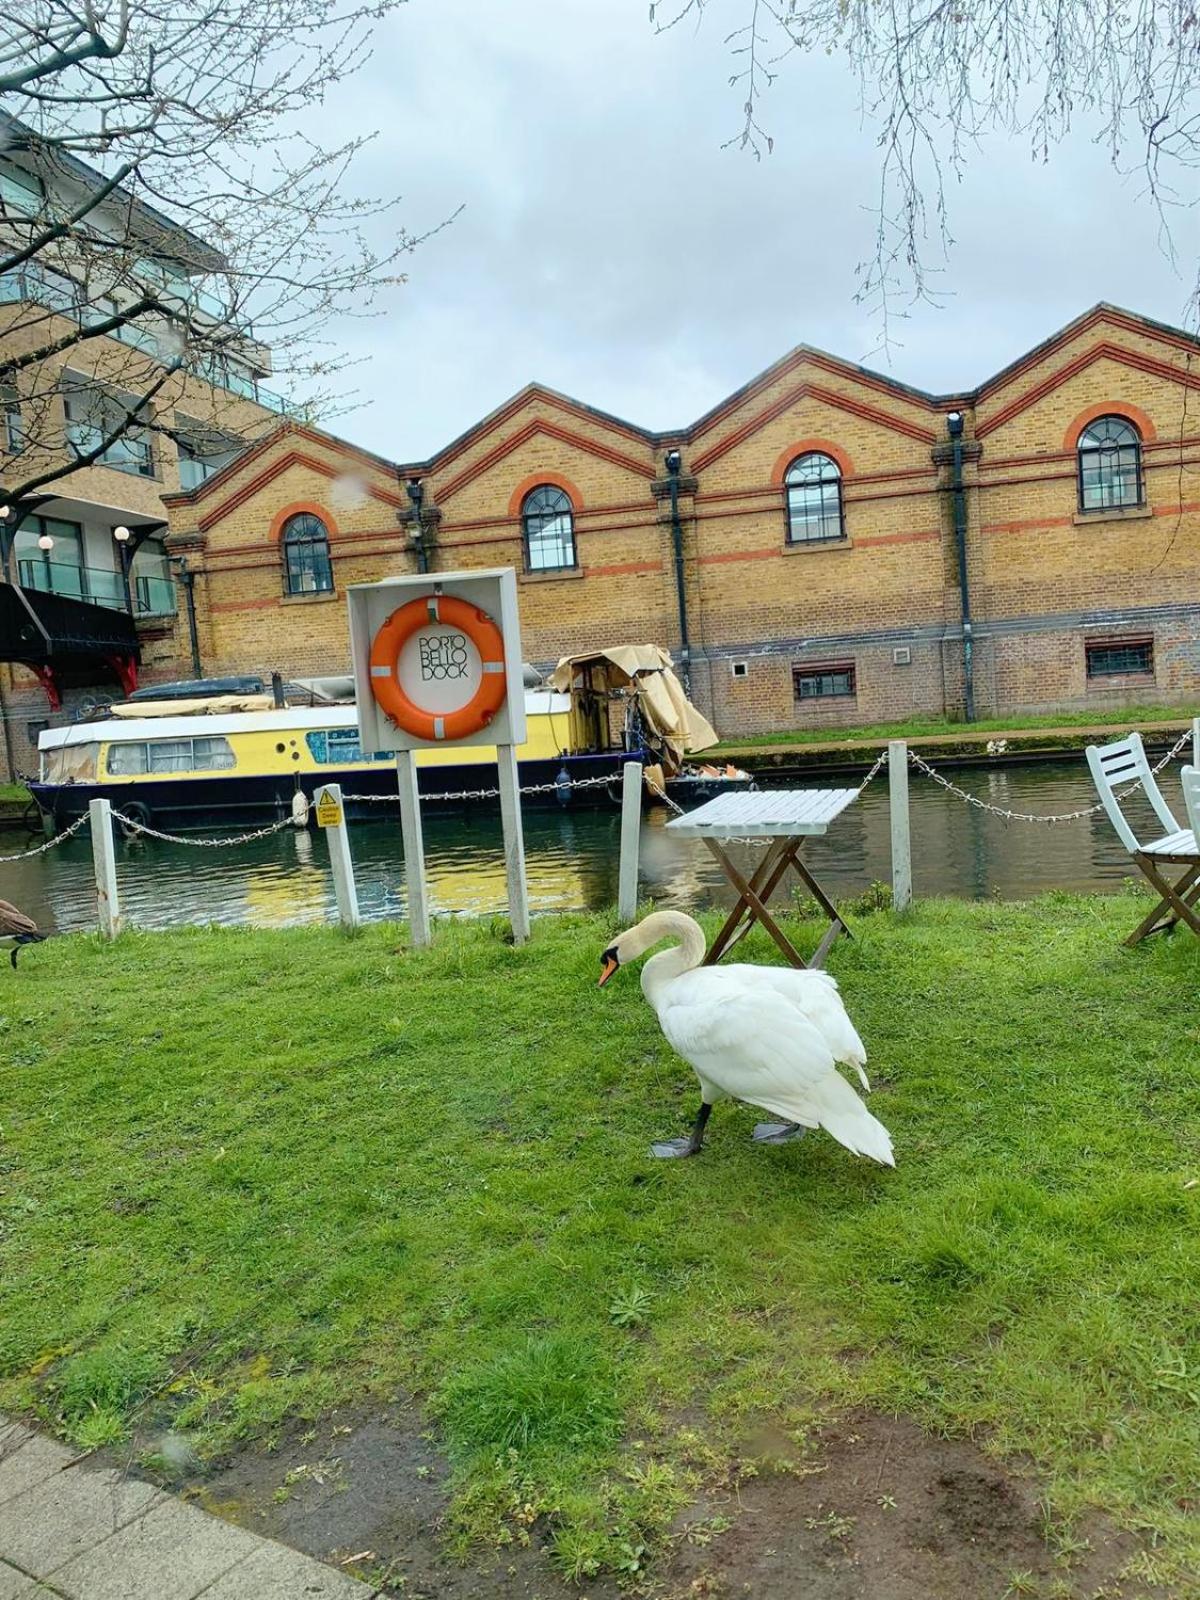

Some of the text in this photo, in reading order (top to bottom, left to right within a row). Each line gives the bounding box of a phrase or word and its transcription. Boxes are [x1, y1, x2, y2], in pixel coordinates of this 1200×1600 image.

[419, 635, 466, 651] PORTO
[420, 648, 467, 667] BELLO
[422, 663, 468, 681] DOCK
